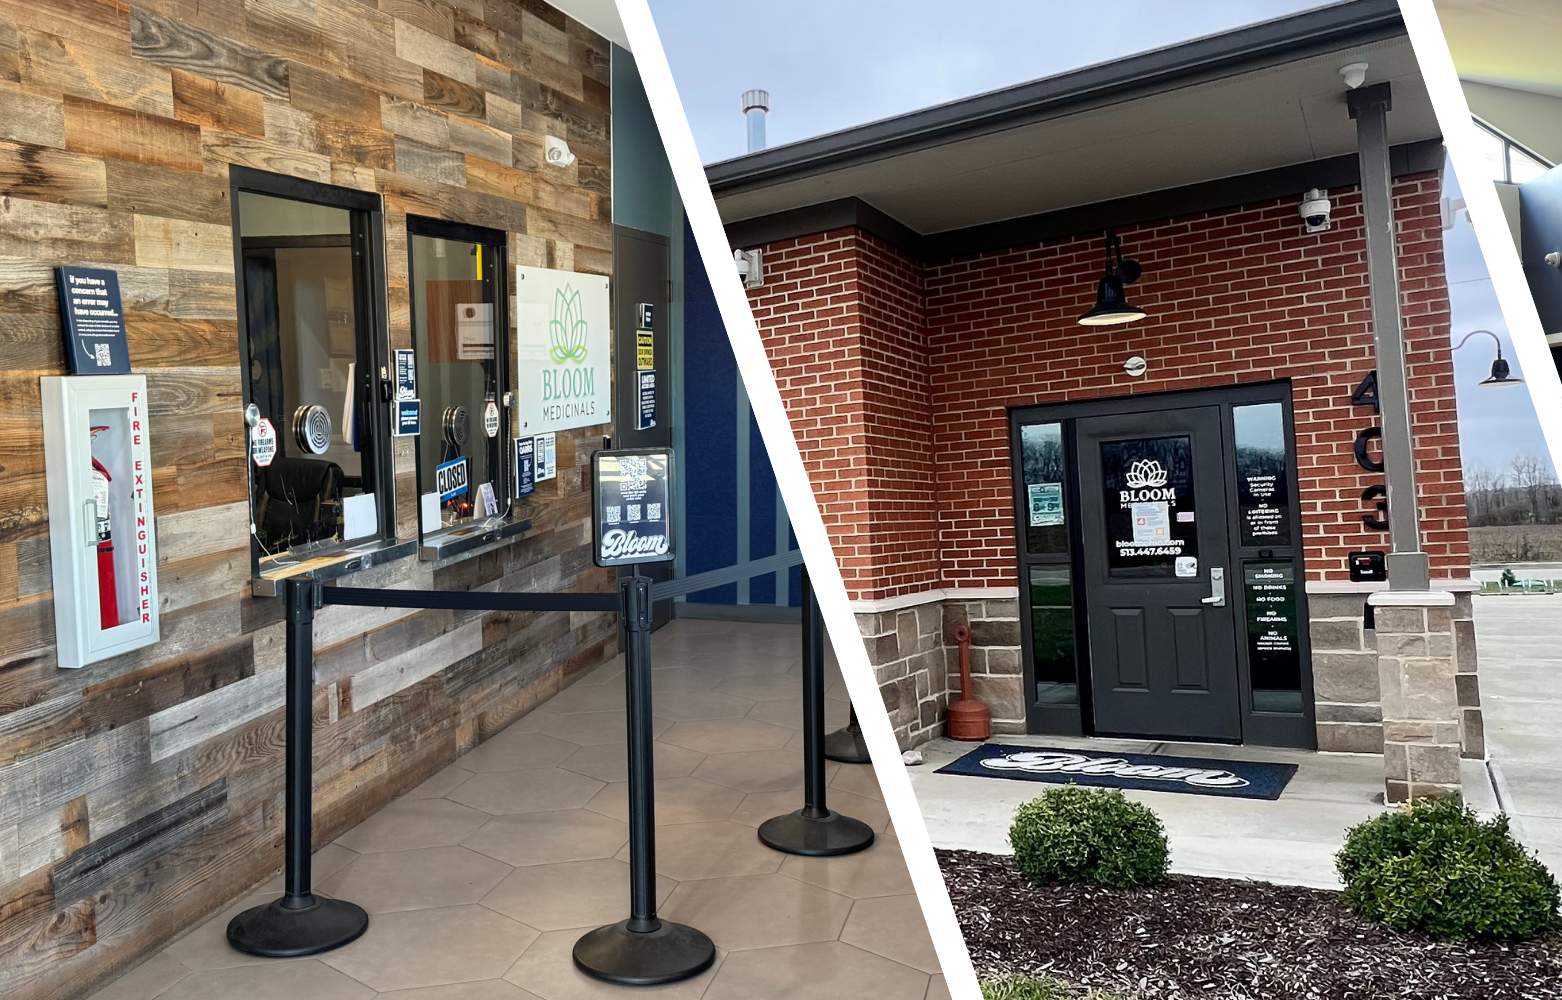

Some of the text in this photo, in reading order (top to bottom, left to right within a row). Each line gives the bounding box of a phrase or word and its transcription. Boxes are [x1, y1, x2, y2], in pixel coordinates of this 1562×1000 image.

[75, 277, 86, 285] you
[86, 277, 100, 285] have
[96, 288, 107, 296] that
[74, 307, 89, 315] have
[97, 299, 108, 308] may
[543, 367, 595, 400] BLOOM
[131, 392, 141, 445] FIRE
[543, 401, 596, 421] MEDICINALS
[438, 463, 466, 494] CLOSED
[1120, 487, 1176, 502] BLOOM
[134, 461, 150, 623] EXTINGUISHER
[601, 528, 669, 559] Bloom
[1120, 546, 1182, 556] 513.447.6459
[979, 751, 1250, 789] Bloom
